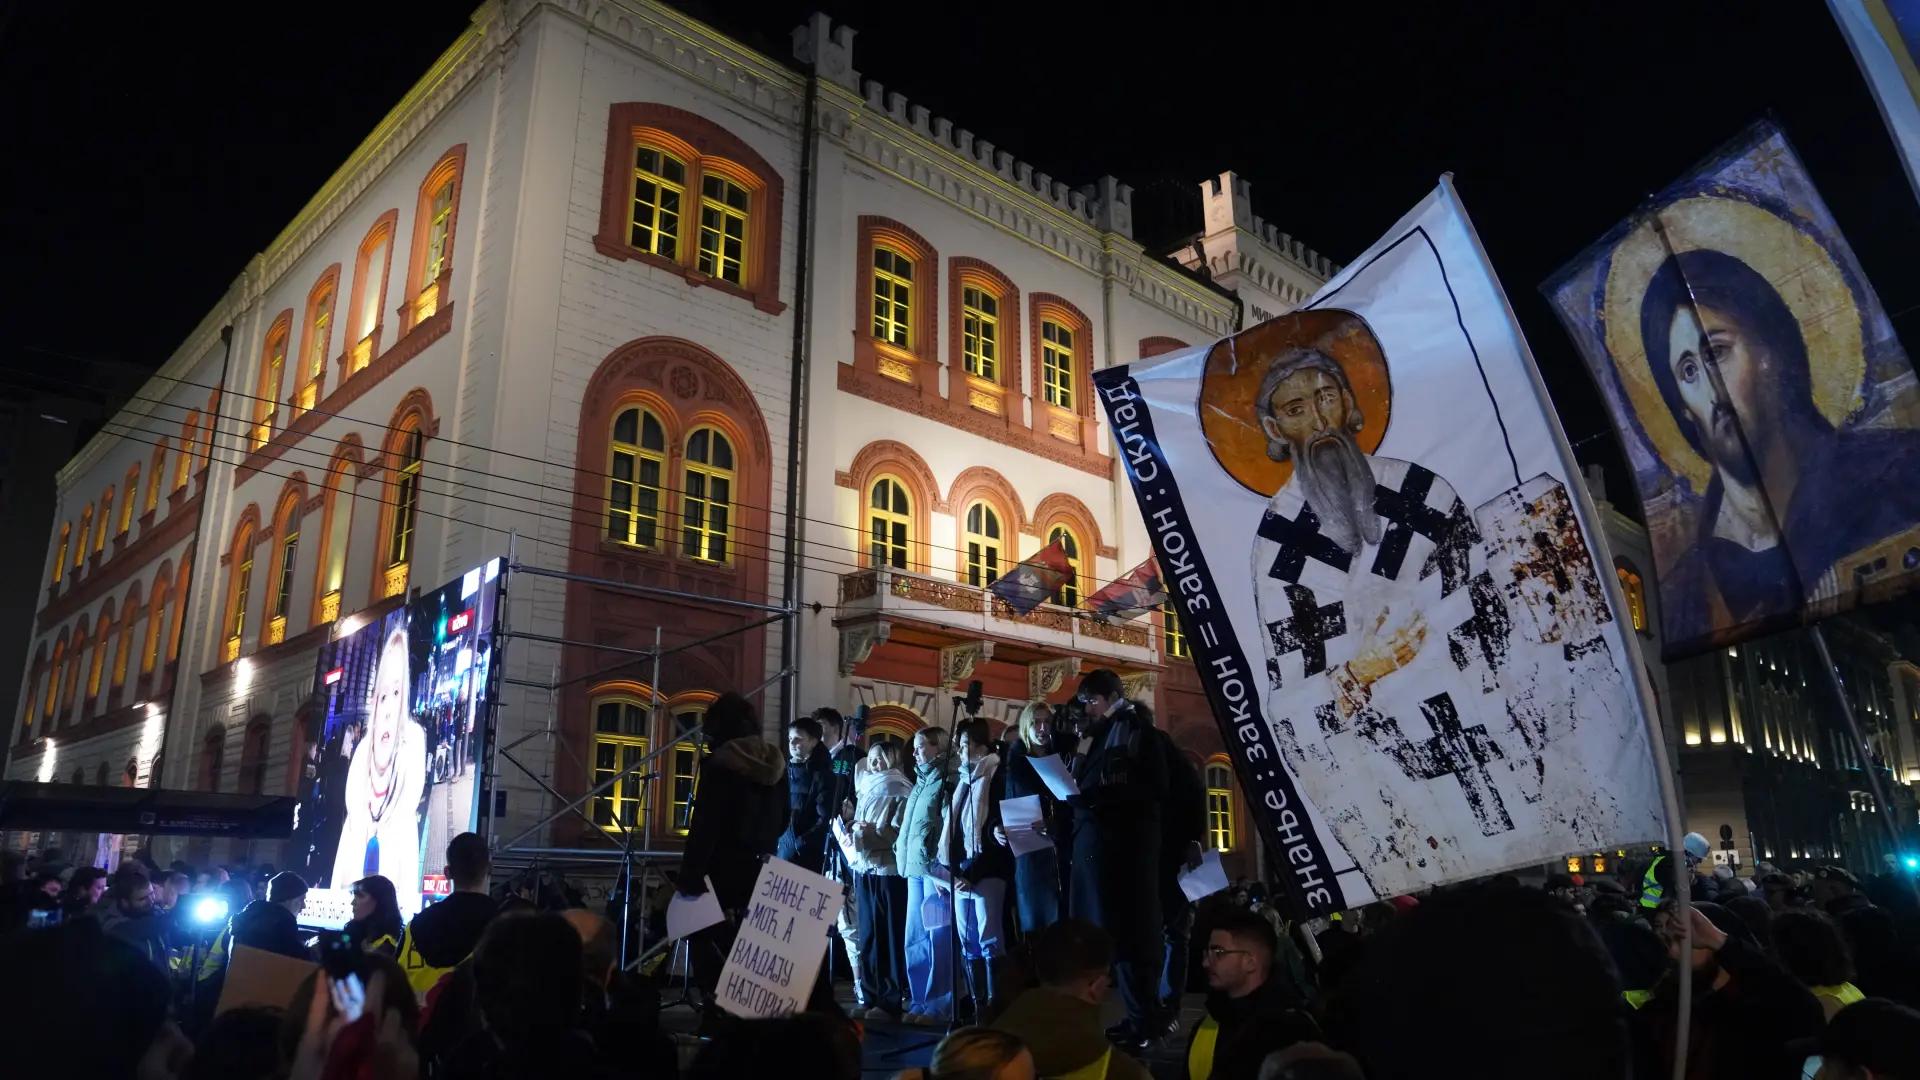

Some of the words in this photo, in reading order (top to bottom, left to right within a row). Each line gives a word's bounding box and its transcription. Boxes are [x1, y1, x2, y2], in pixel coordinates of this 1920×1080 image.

[762, 870, 810, 912] ЗНАЊЕ
[809, 891, 831, 921] ЈЕ
[782, 917, 795, 944] А
[731, 937, 794, 988] ВЛАДАЈУ
